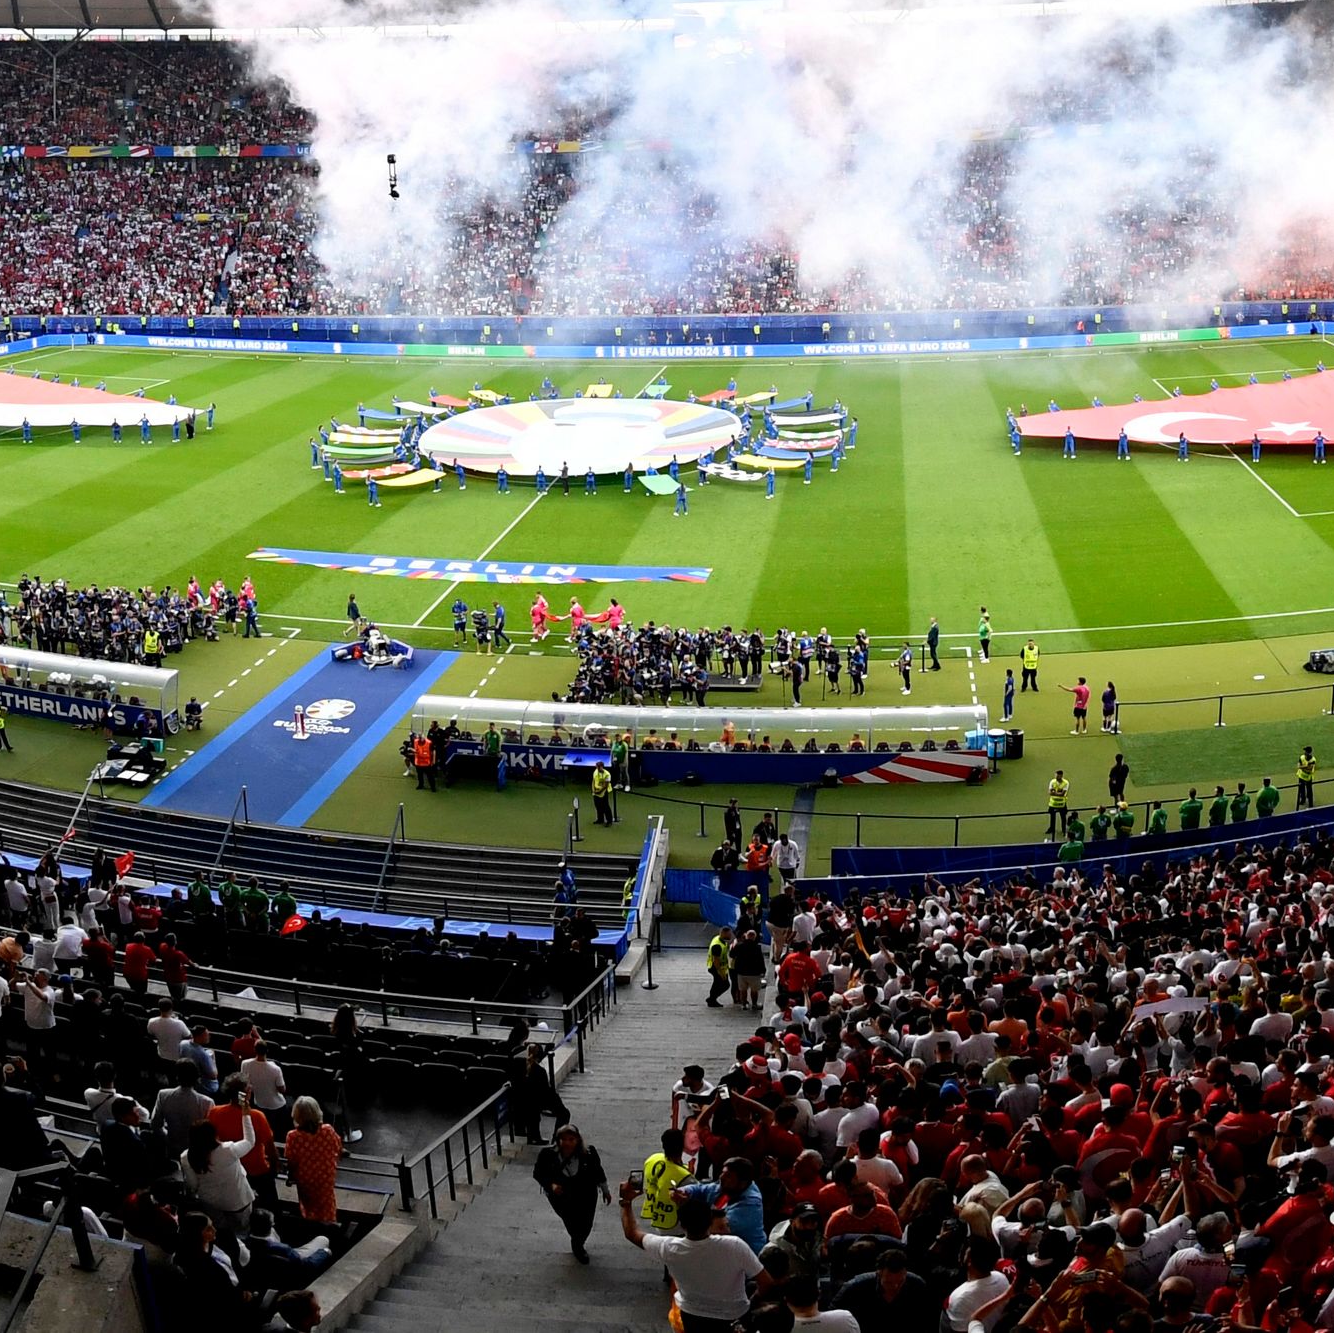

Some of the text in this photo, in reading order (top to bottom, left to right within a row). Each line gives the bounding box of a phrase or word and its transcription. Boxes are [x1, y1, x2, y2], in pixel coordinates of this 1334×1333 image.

[1139, 331, 1178, 342] BERLIN
[148, 337, 288, 351] WELCOME TO UEFA EURO 2024
[804, 341, 970, 354] WELCOME TO UEFA EURO 2024
[447, 346, 486, 356] BERLIN
[369, 558, 578, 576] BERLIN
